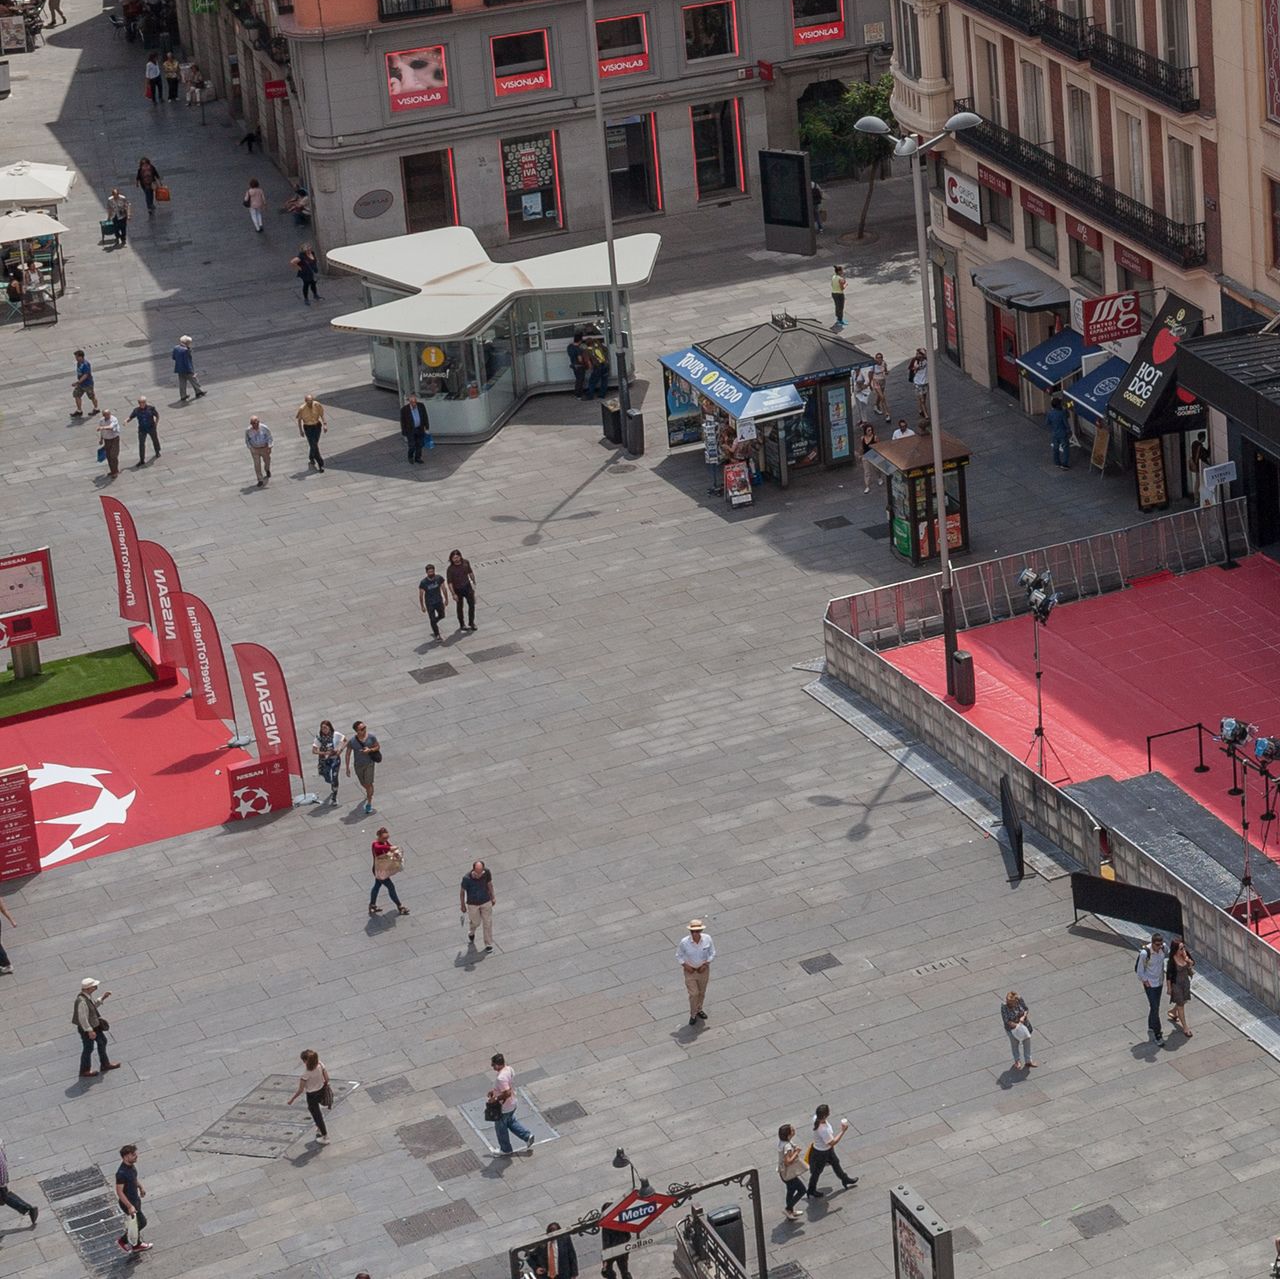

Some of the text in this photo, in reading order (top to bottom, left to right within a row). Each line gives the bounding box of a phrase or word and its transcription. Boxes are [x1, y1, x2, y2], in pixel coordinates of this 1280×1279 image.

[798, 27, 838, 39] VISIONLAB
[601, 59, 643, 73] VISIONLAB
[500, 76, 545, 90] VISIONLAB
[397, 93, 442, 105] VISIONLAB
[523, 168, 537, 177] IVA
[1089, 321, 1117, 330] CENTROS
[1089, 326, 1117, 335] CAPILARES
[677, 353, 743, 403] TOURS TOLEDO
[1136, 362, 1163, 386] HOT
[1128, 377, 1153, 399] DOG
[1123, 391, 1146, 408] GOURMET
[236, 770, 264, 780] NISSAN
[622, 1205, 654, 1221] Metro
[625, 1239, 653, 1251] Callao
